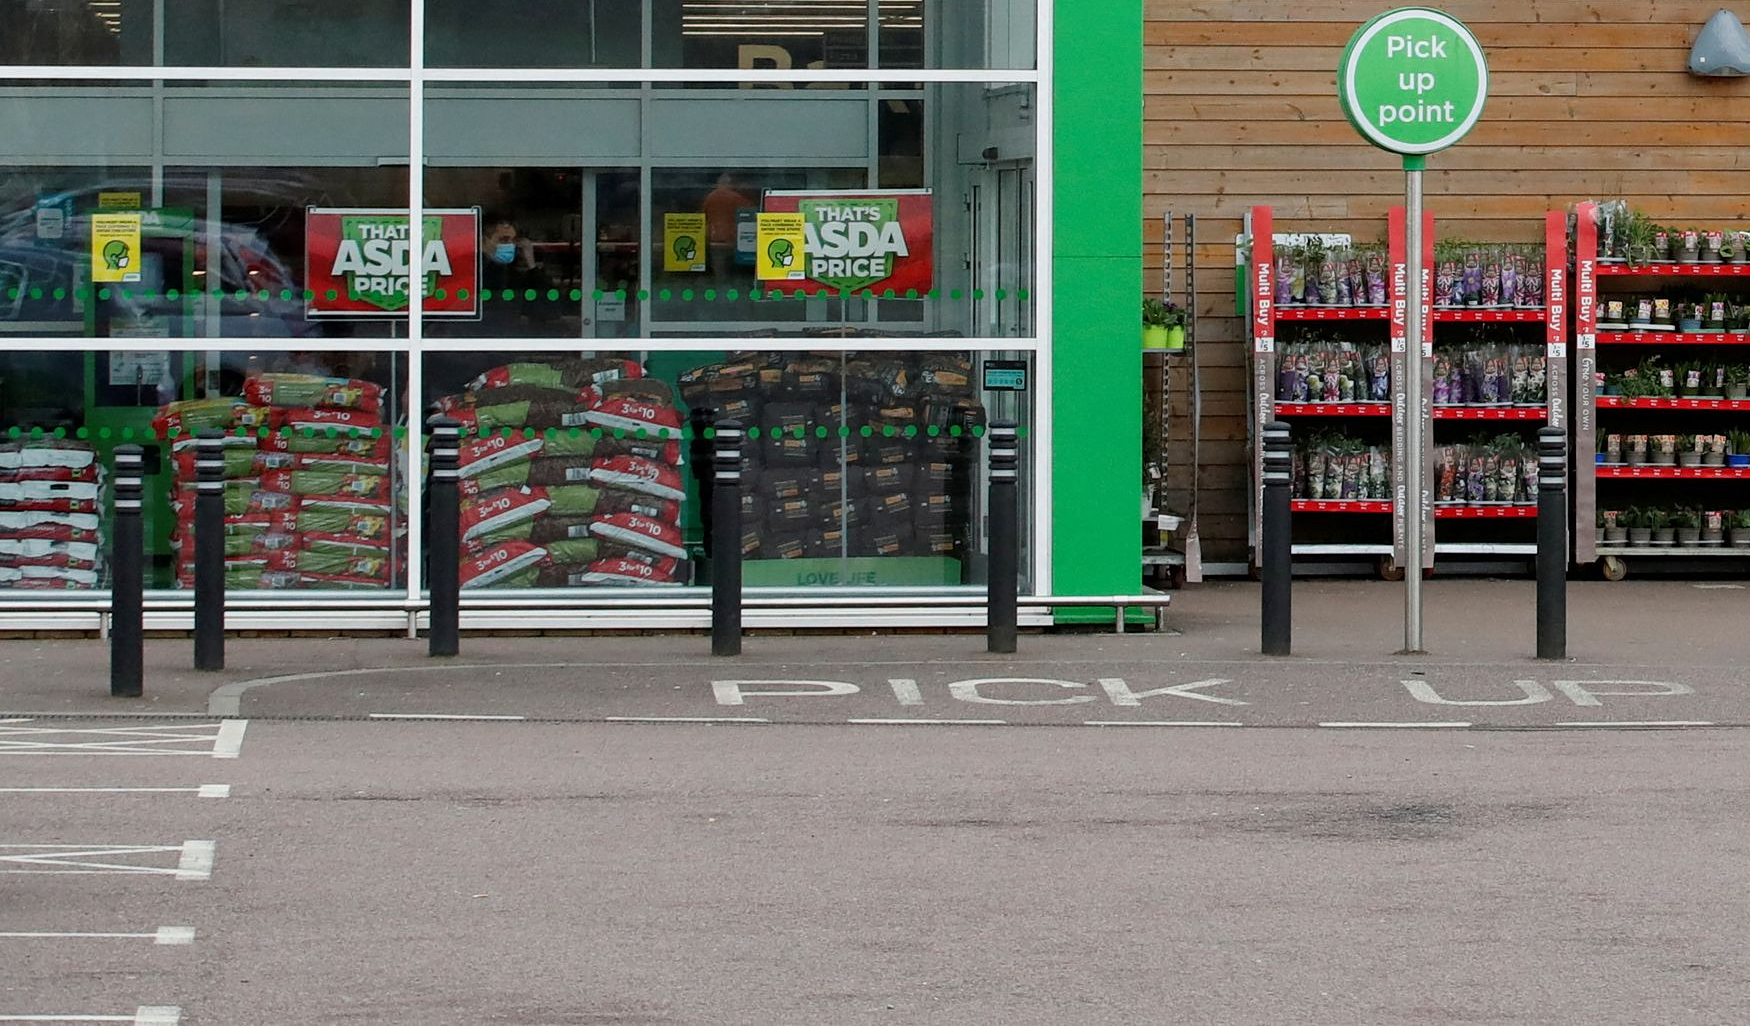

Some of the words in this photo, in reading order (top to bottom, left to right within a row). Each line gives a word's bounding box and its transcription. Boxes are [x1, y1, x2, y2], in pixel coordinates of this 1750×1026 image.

[1387, 35, 1447, 58] Pick
[1399, 72, 1435, 94] up
[1379, 99, 1455, 126] point
[816, 206, 881, 221] THAT'S
[804, 222, 909, 257] ASDA
[331, 239, 452, 276] ASDA
[812, 259, 885, 277] PRICE
[1258, 263, 1270, 296] Multi
[1394, 263, 1405, 296] Multi
[1551, 269, 1562, 301] Multi
[1581, 260, 1592, 292] Multi
[1257, 299, 1270, 325] Buy
[1393, 299, 1405, 325] Buy
[1550, 305, 1562, 331] Buy
[1580, 296, 1592, 322] Buy
[797, 573, 839, 585] LOVE
[711, 677, 1250, 707] PICK
[1401, 678, 1695, 707] UP
